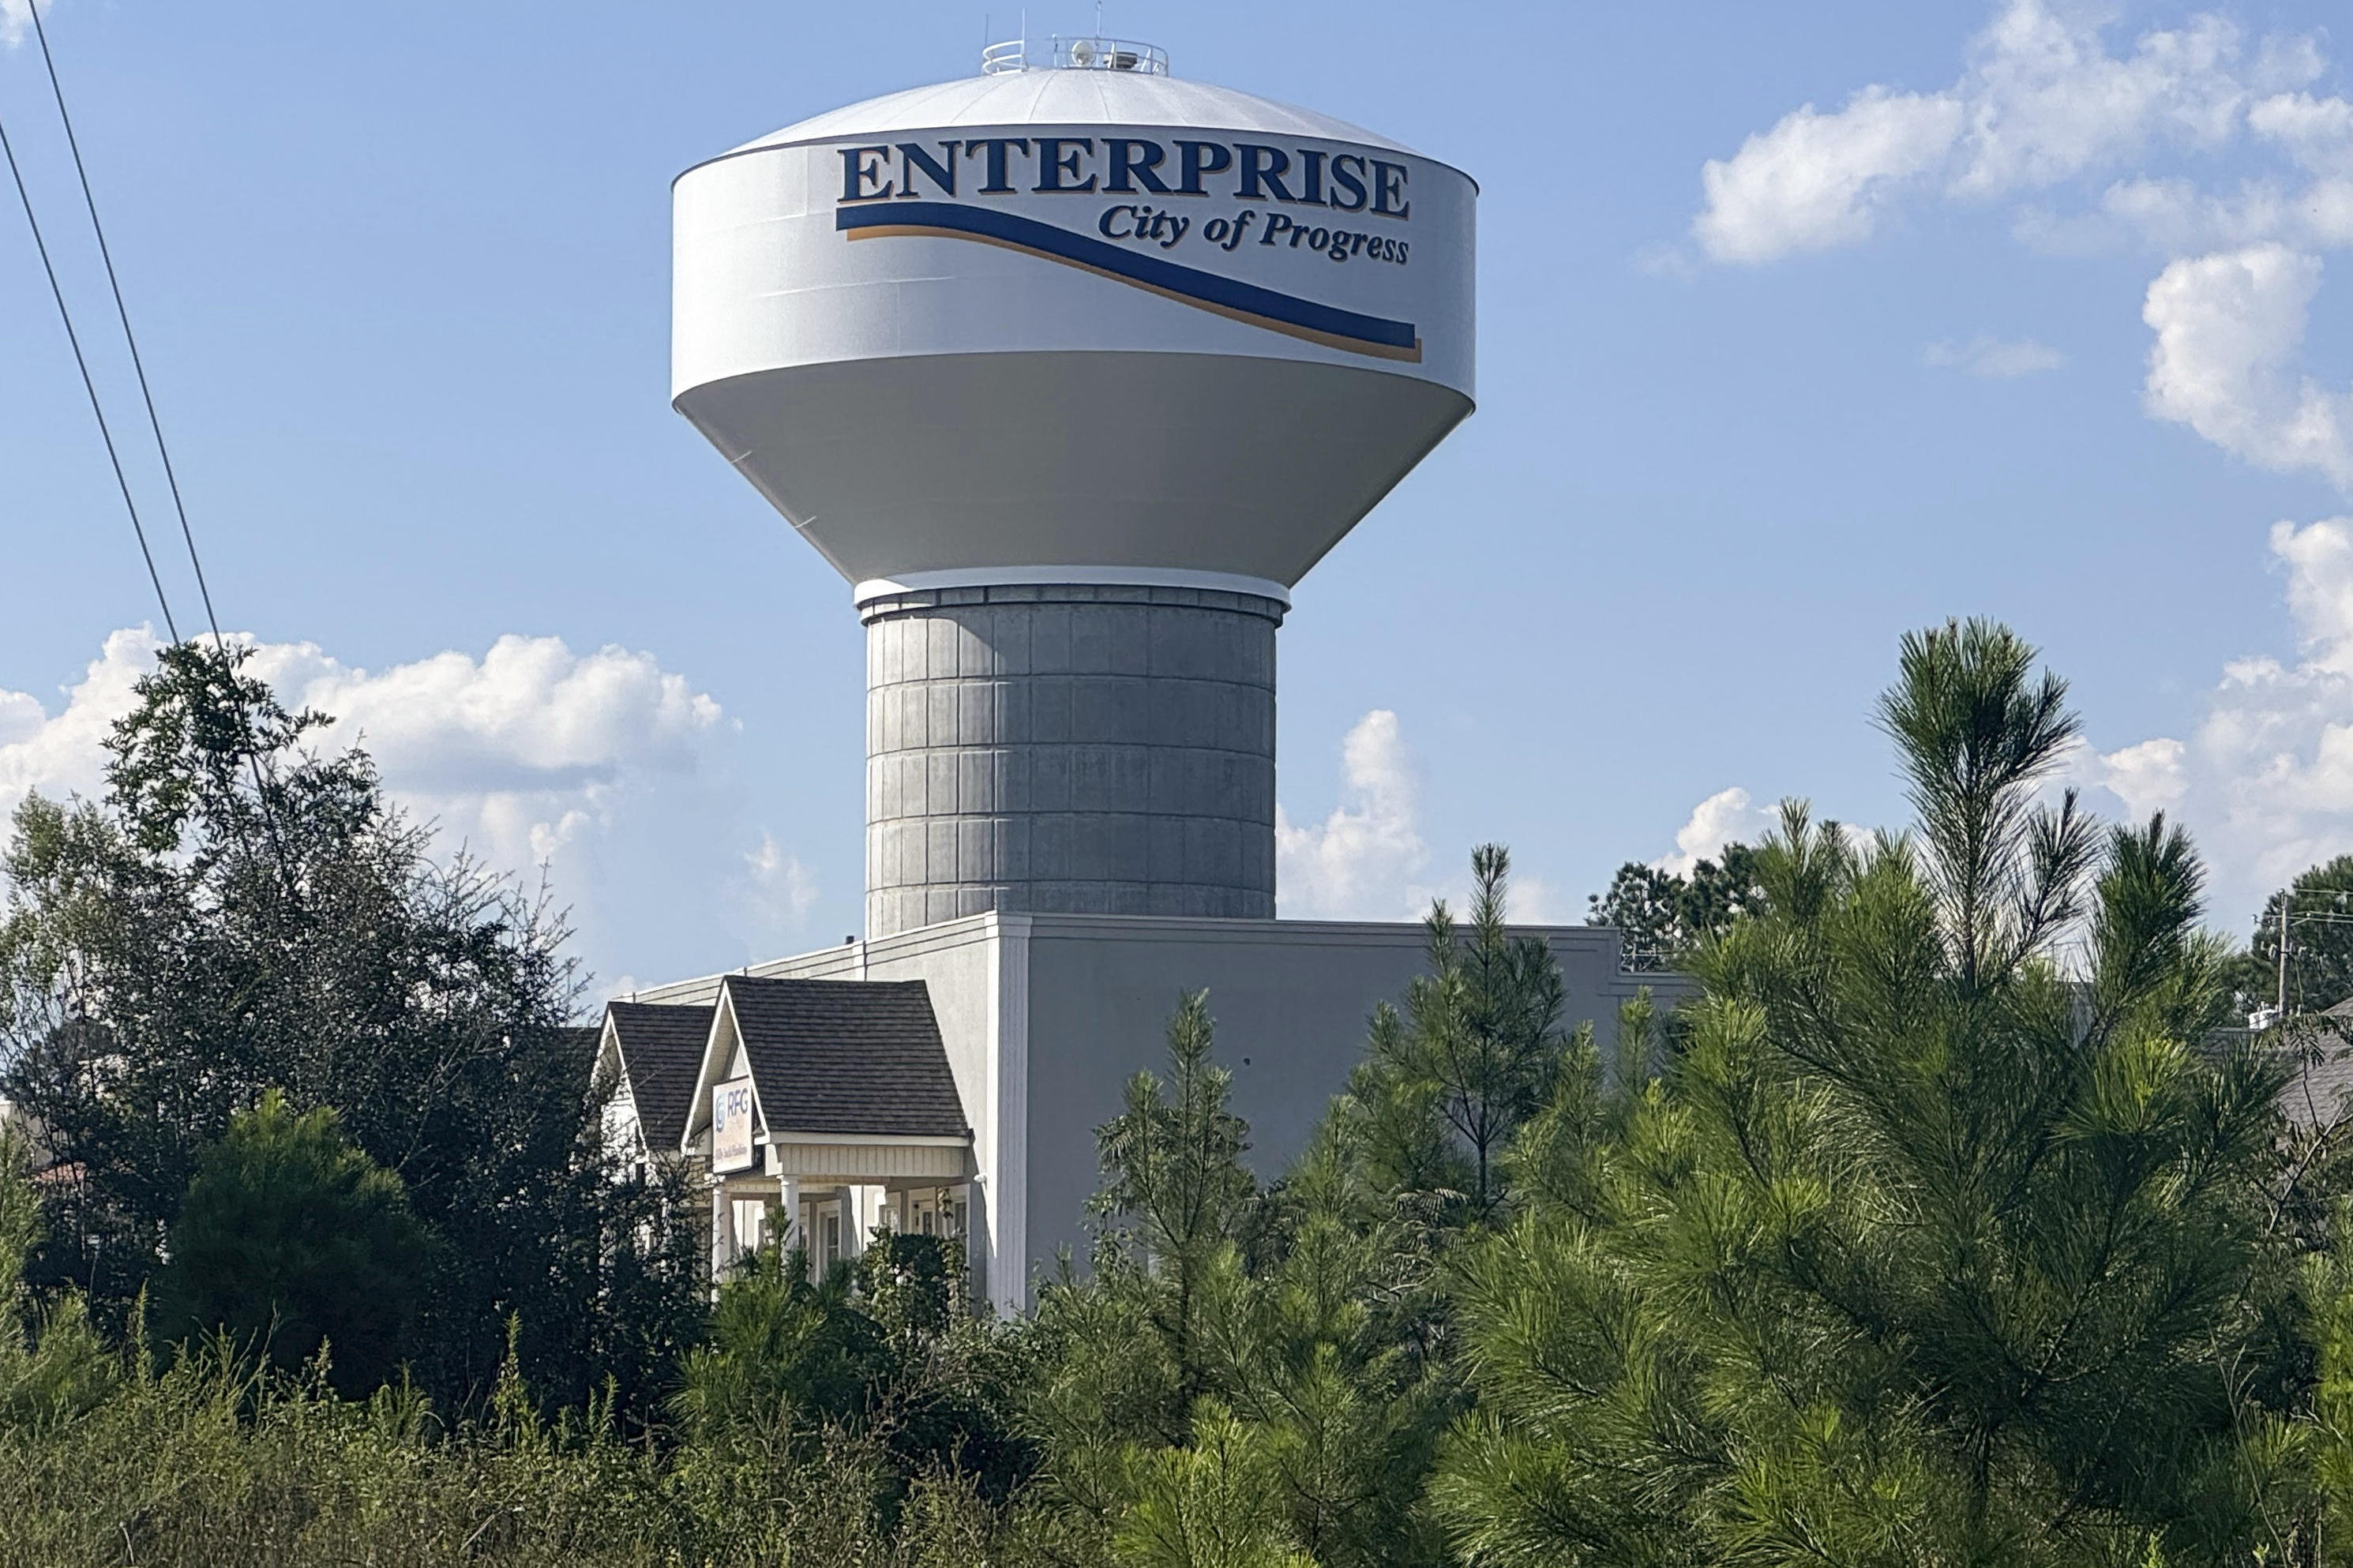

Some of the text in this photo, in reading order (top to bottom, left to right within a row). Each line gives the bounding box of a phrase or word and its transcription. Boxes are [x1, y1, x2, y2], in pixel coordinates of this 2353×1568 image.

[837, 137, 1410, 220] ENTERPRISE
[1098, 205, 1409, 265] City of Progress
[727, 1088, 748, 1117] RFG
